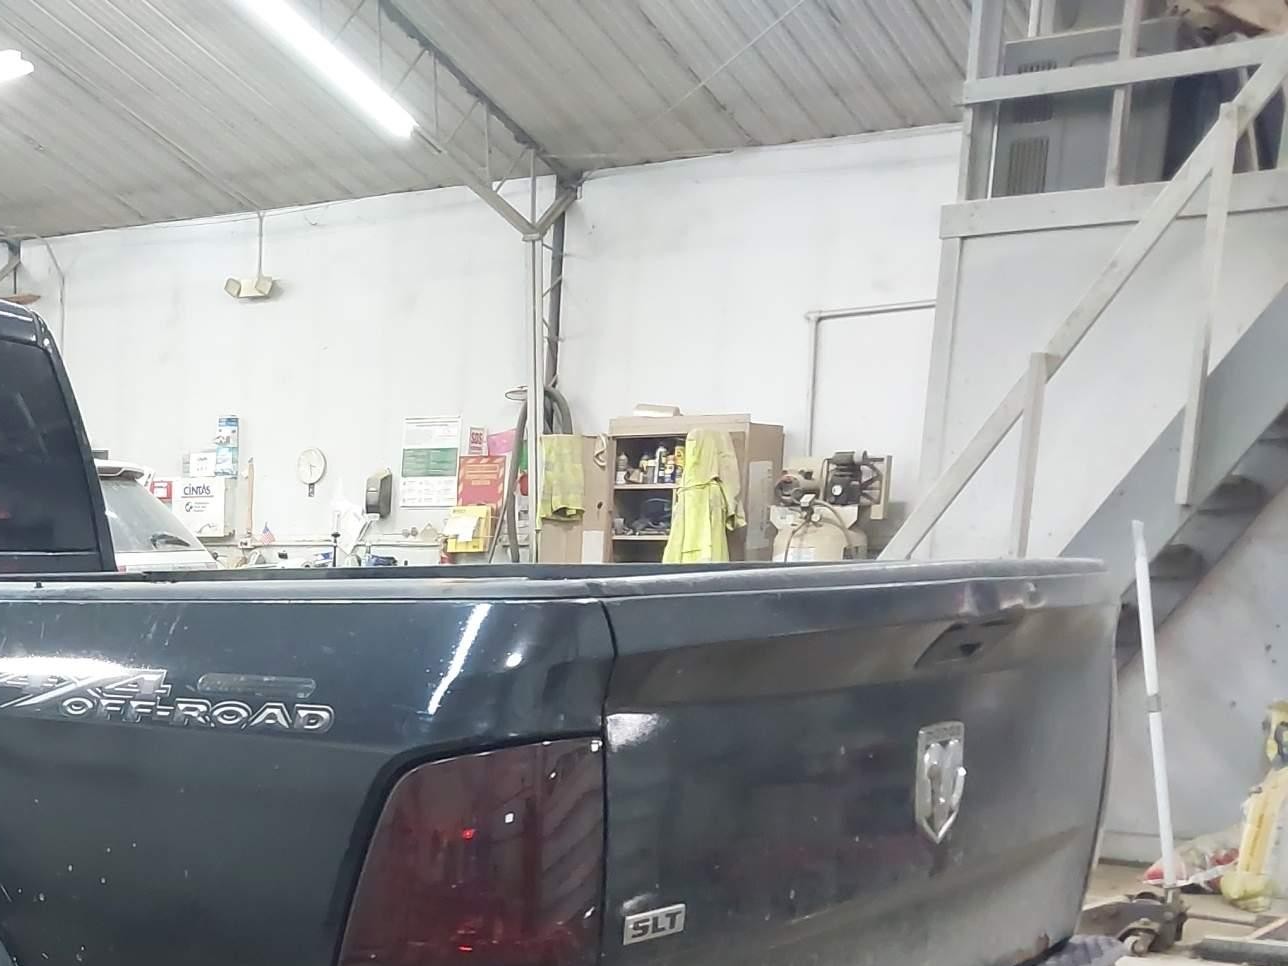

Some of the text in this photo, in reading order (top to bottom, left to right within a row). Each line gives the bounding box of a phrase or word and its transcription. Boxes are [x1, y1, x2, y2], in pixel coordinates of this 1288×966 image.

[183, 483, 211, 496] CINTAS
[59, 696, 336, 735] OFF-ROAD
[630, 910, 682, 939] SLT
